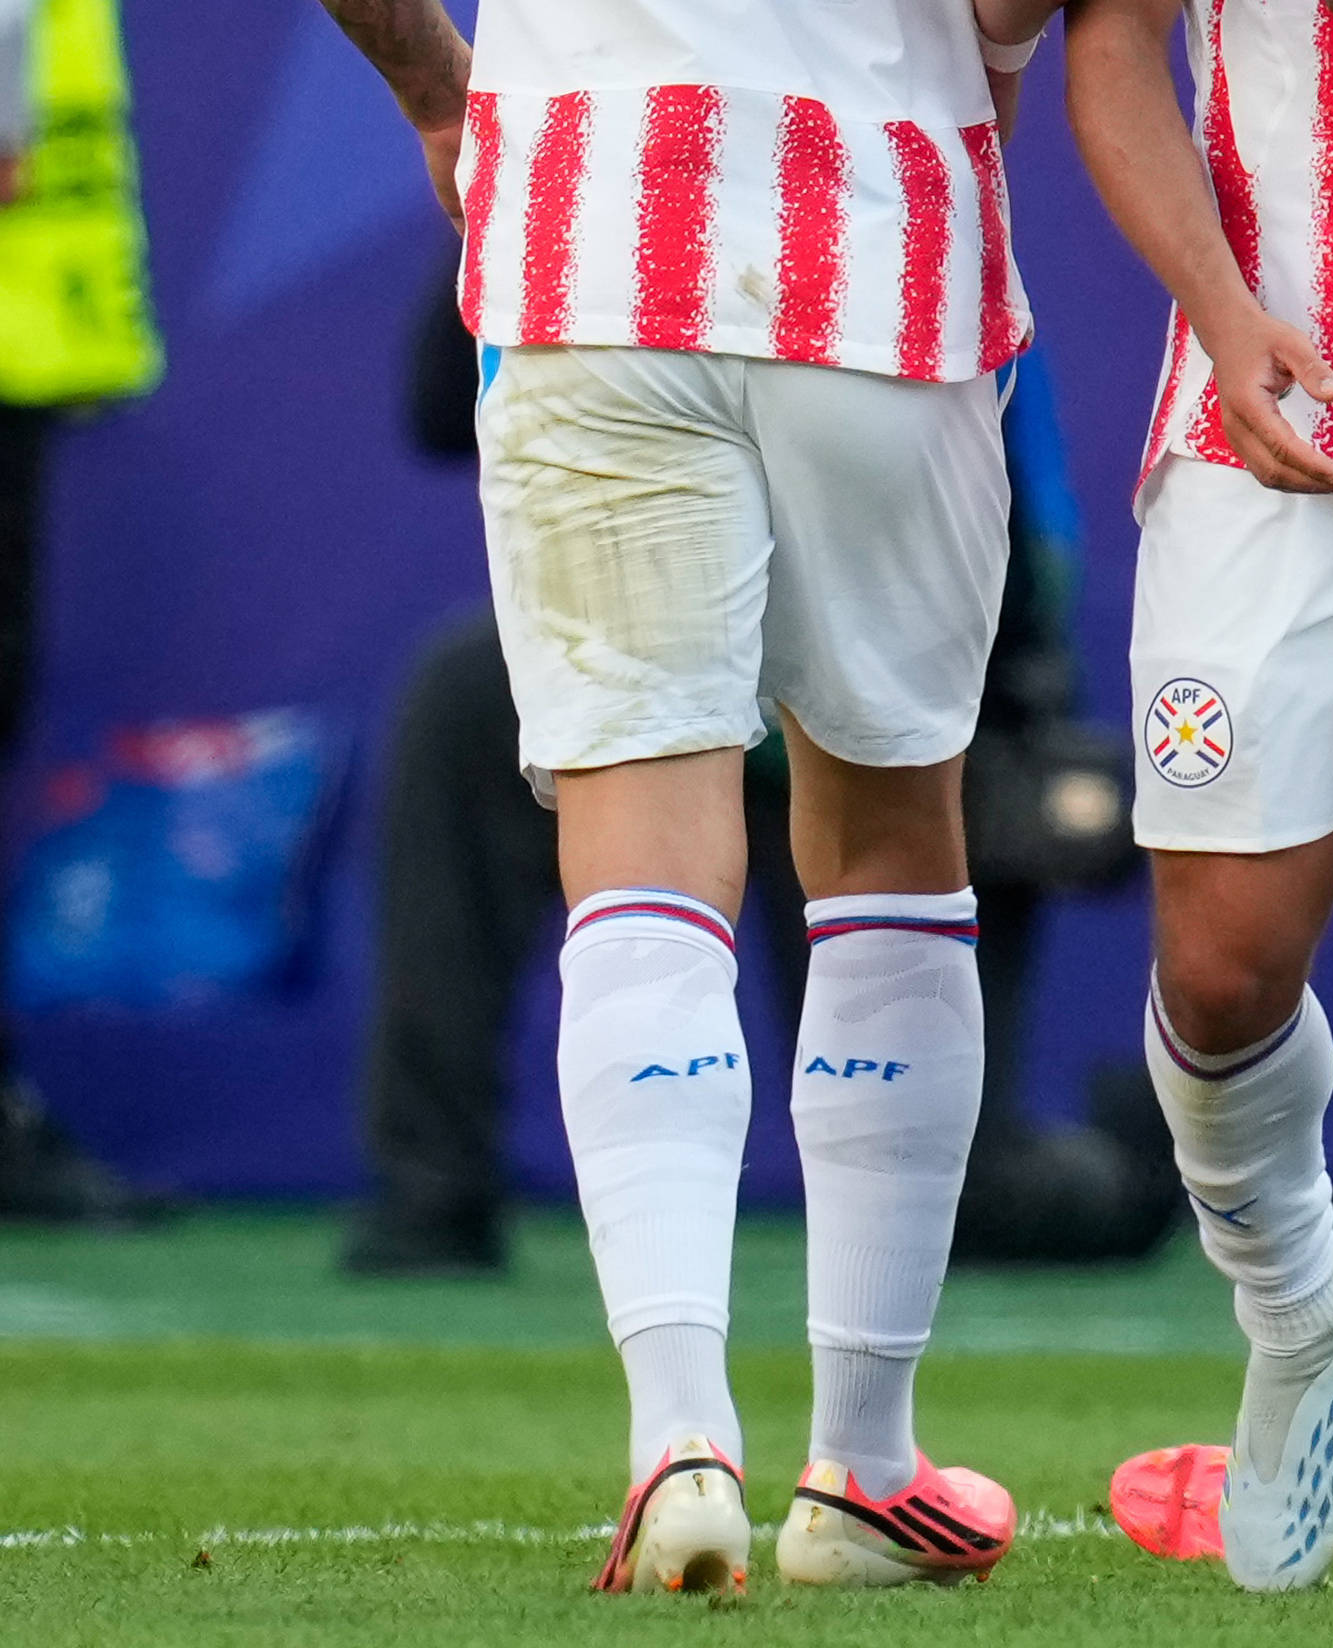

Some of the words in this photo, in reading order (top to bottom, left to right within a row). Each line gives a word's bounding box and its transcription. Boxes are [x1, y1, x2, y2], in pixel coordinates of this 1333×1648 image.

[1171, 688, 1202, 704] APF
[630, 1052, 740, 1082] APF
[805, 1057, 911, 1082] APF
